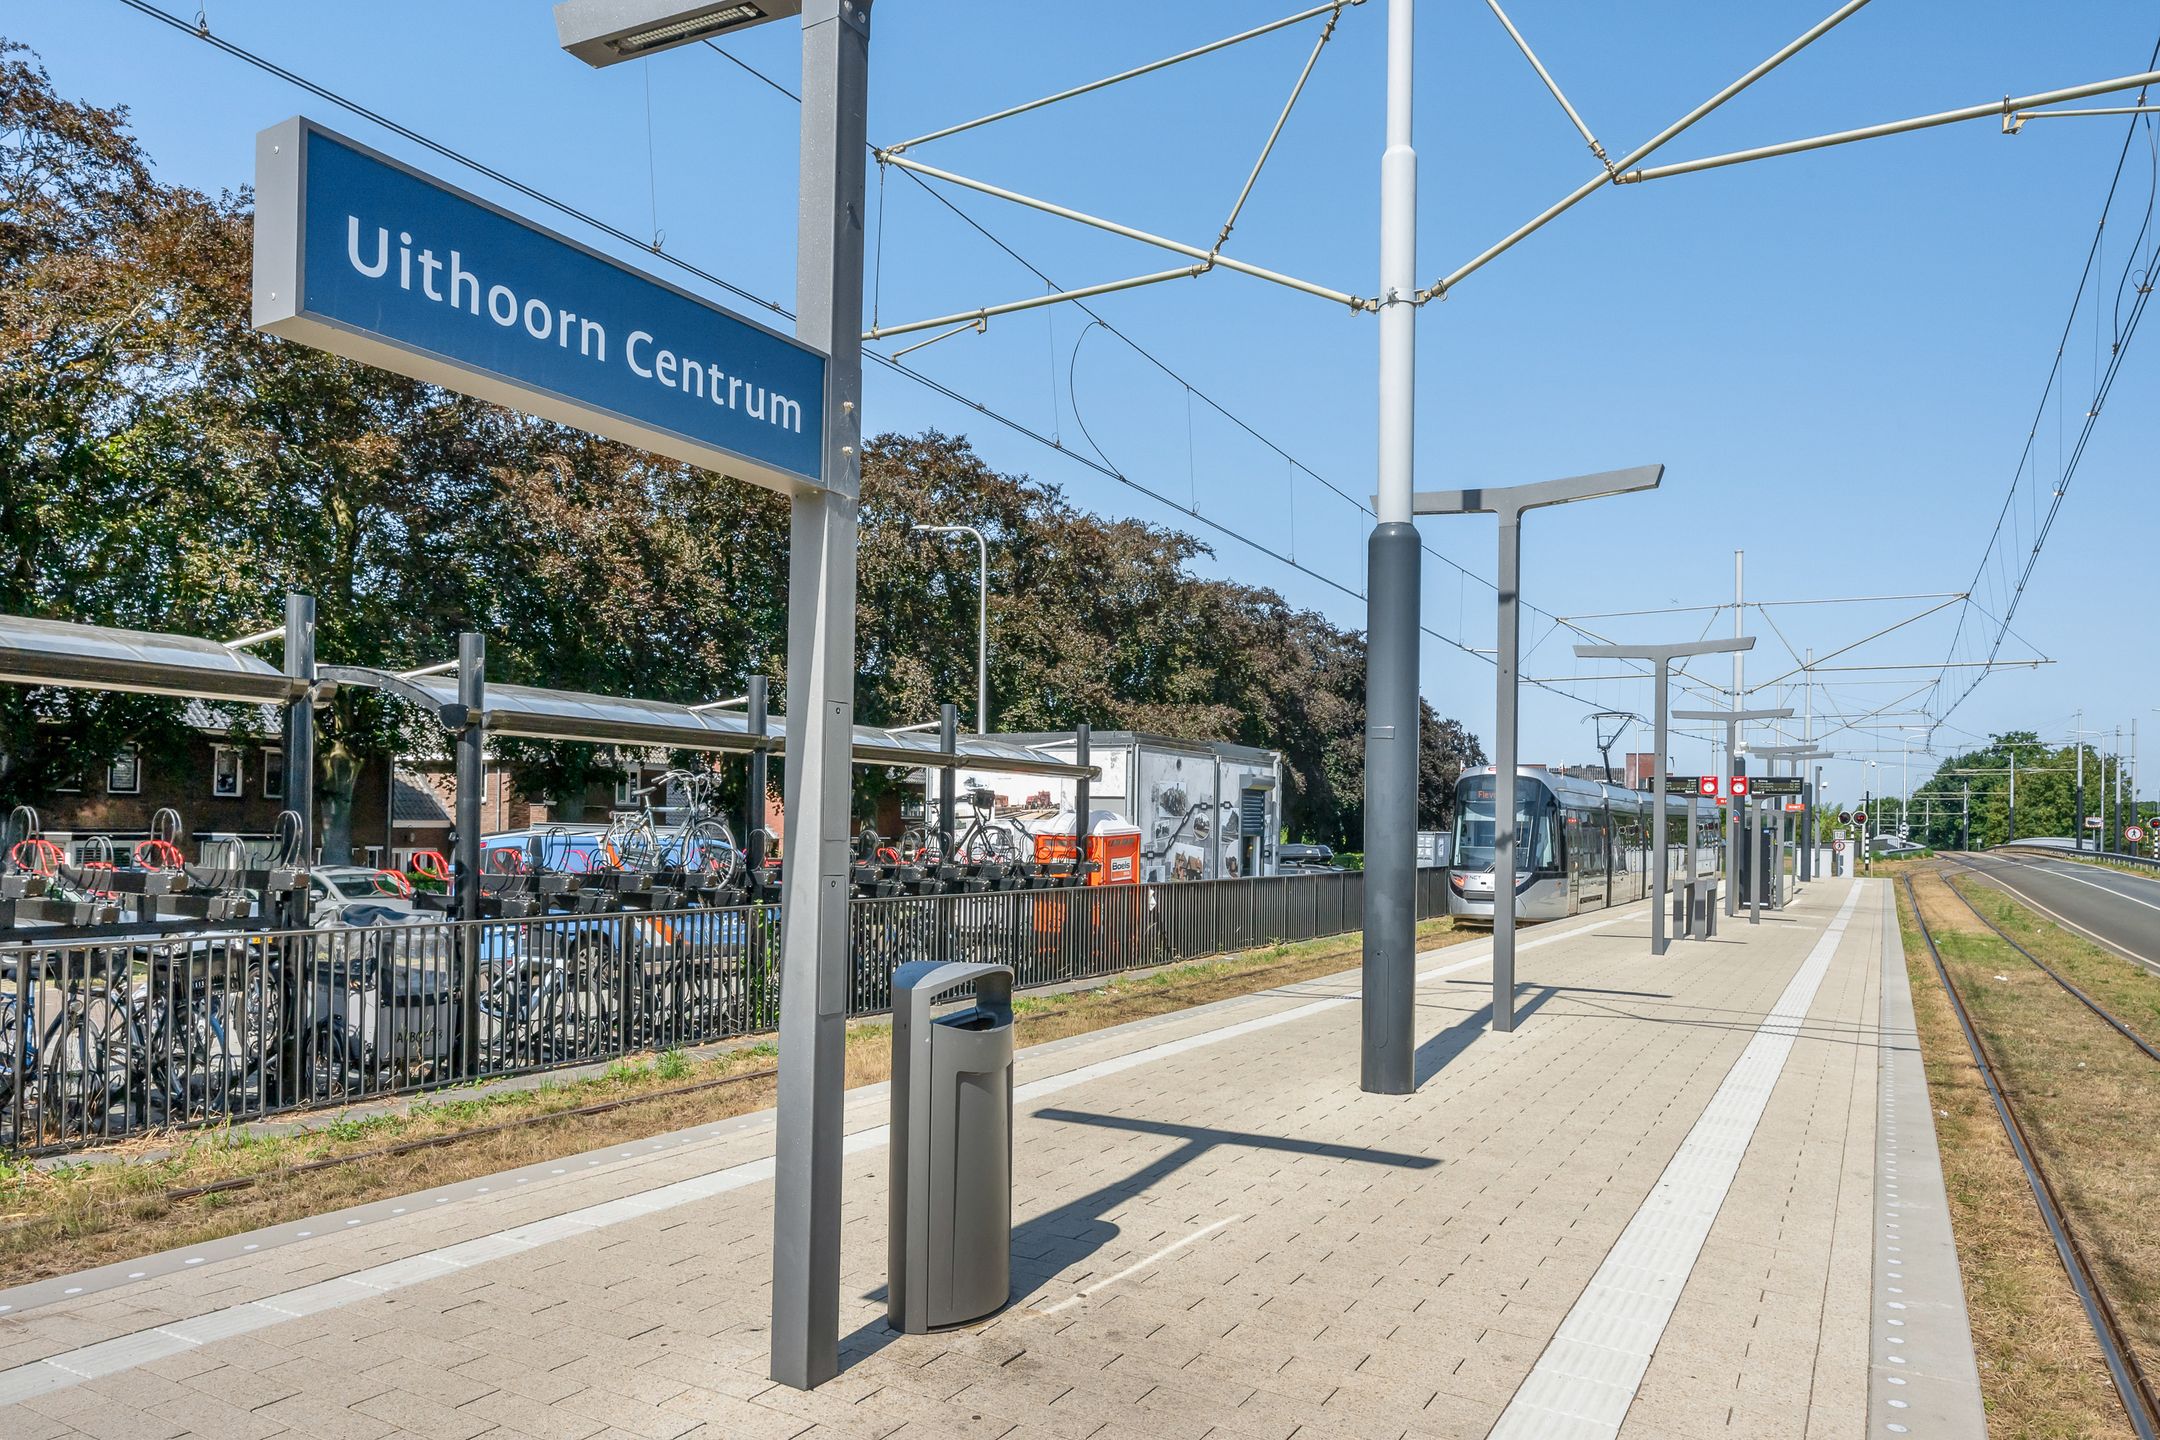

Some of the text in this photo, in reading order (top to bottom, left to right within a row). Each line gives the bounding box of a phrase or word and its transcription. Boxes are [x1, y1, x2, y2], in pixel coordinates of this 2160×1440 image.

[347, 214, 801, 434] Uithoorn Centrum
[1112, 860, 1131, 871] Boels
